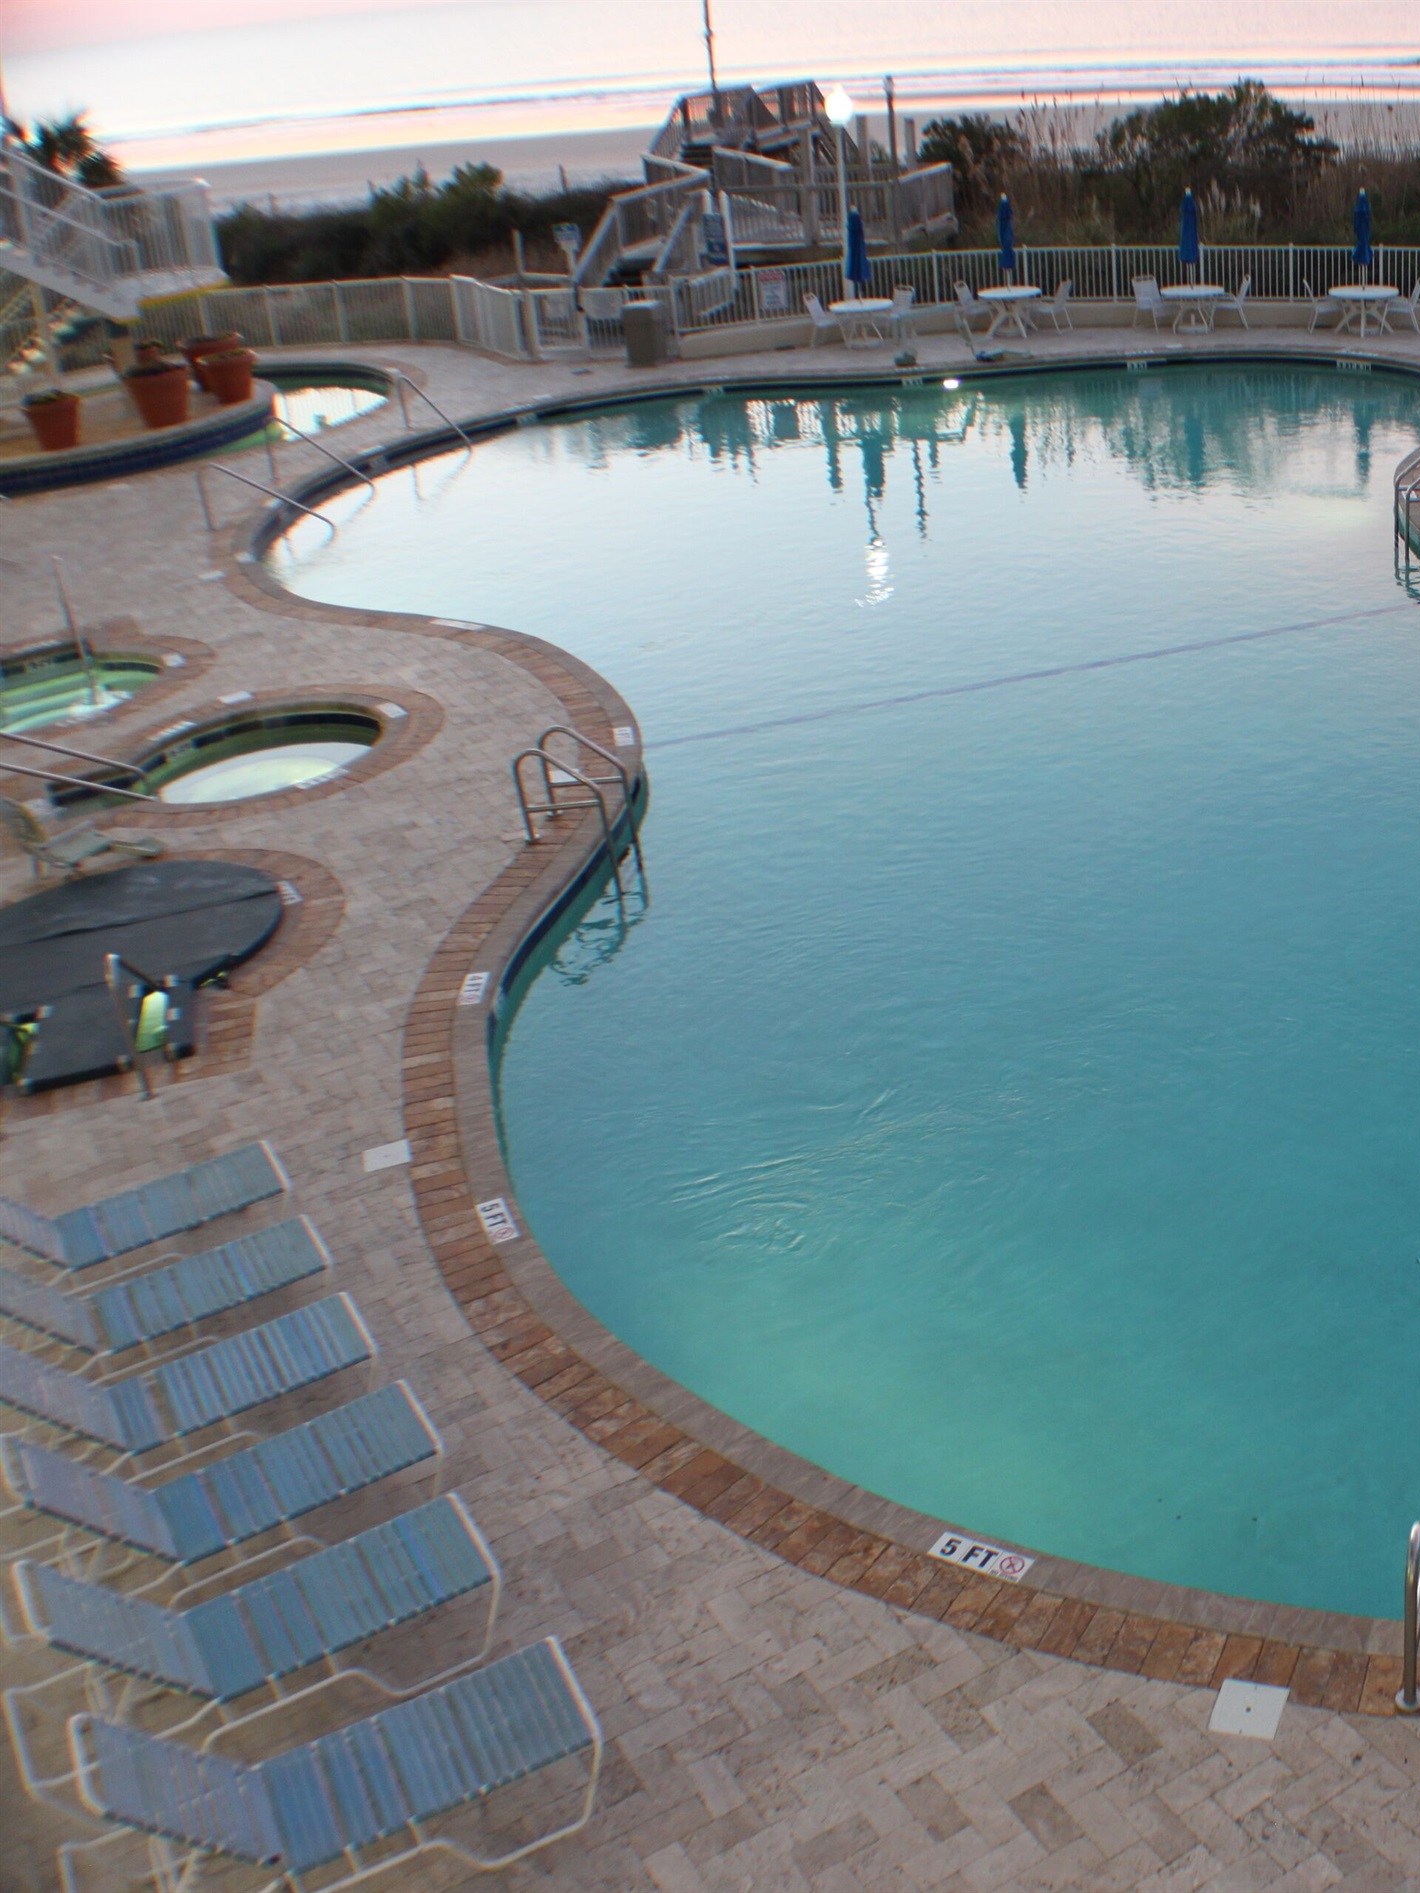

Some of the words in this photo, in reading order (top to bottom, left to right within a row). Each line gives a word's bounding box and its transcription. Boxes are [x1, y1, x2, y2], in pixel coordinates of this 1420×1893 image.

[480, 1202, 501, 1213] 5
[484, 1212, 508, 1228] FT
[940, 1537, 962, 1557] 5
[961, 1544, 999, 1568] FT
